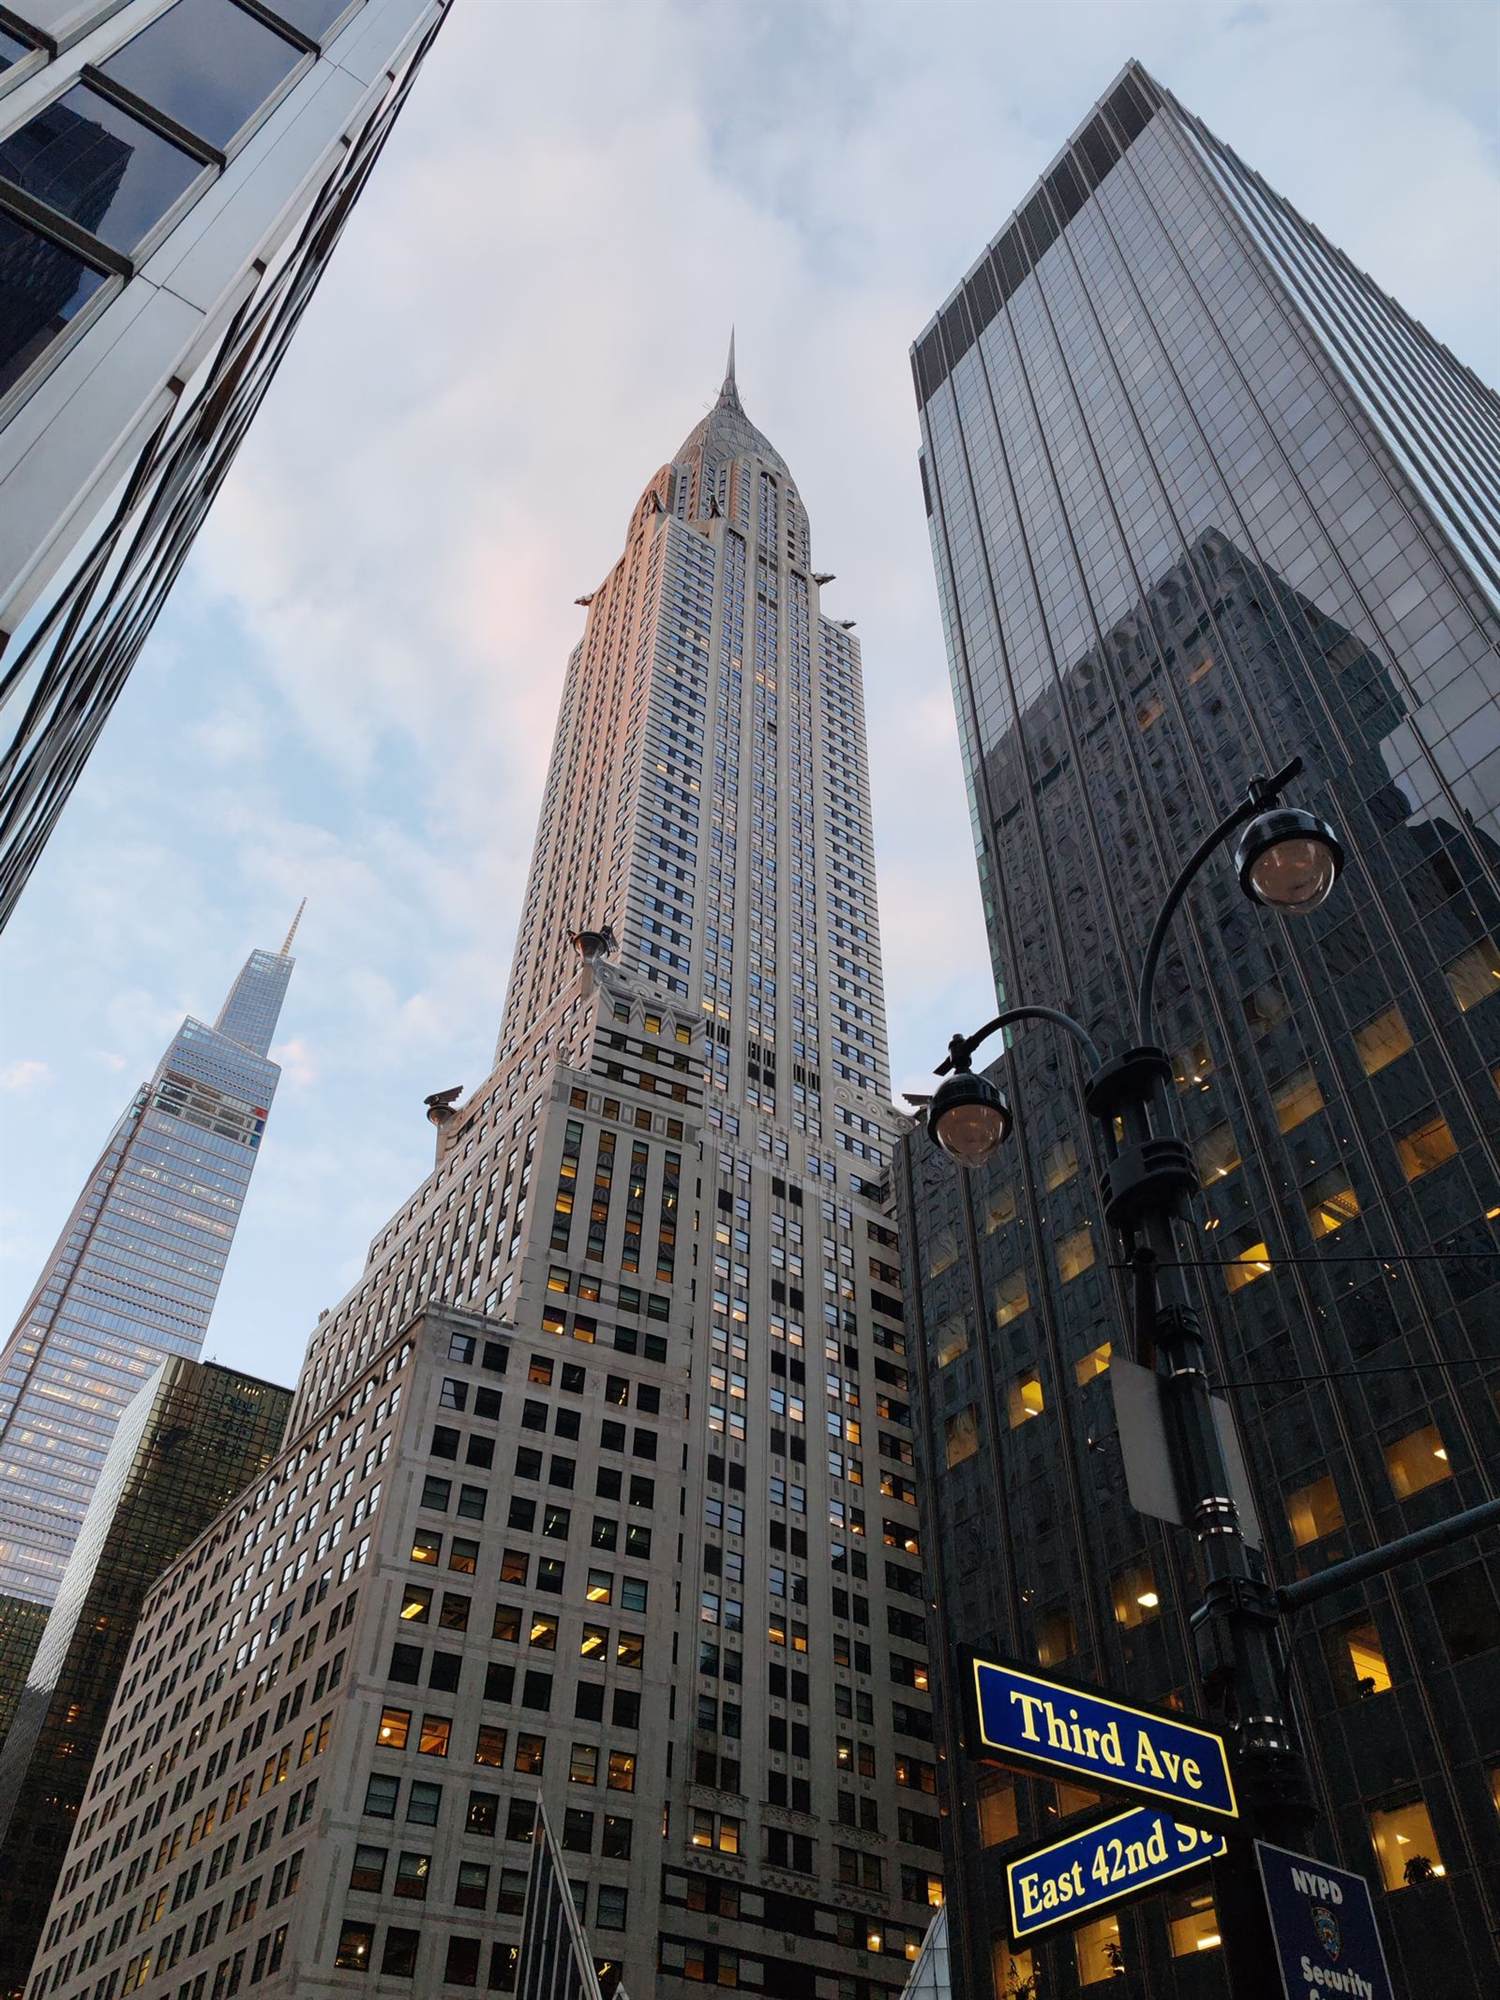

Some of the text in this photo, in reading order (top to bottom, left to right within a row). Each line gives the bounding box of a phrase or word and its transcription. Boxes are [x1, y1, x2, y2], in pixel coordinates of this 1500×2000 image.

[1010, 1691, 1203, 1789] Third Ave
[1019, 1860, 1085, 1918] East
[1091, 1818, 1169, 1886] 42nd
[1291, 1867, 1343, 1905] NYPD
[1301, 1955, 1372, 2000] Security
